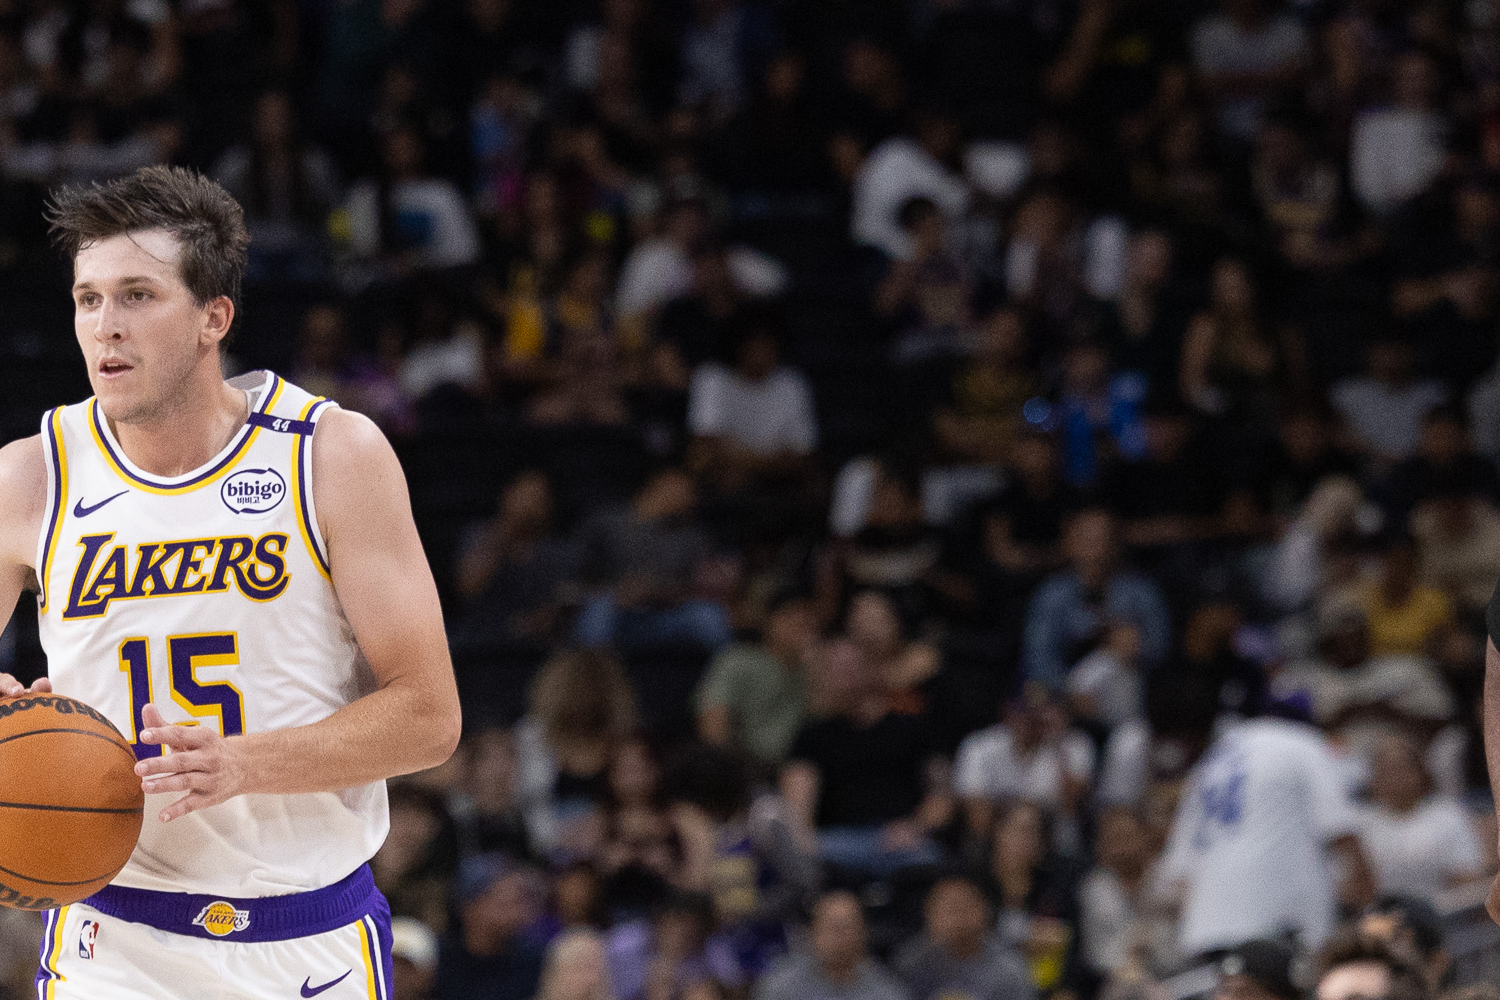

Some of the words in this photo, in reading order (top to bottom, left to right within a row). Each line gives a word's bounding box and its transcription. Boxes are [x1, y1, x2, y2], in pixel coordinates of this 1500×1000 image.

[272, 418, 292, 432] 44
[227, 480, 282, 500] bibigo
[62, 531, 292, 622] LAKERS
[118, 631, 246, 762] 15
